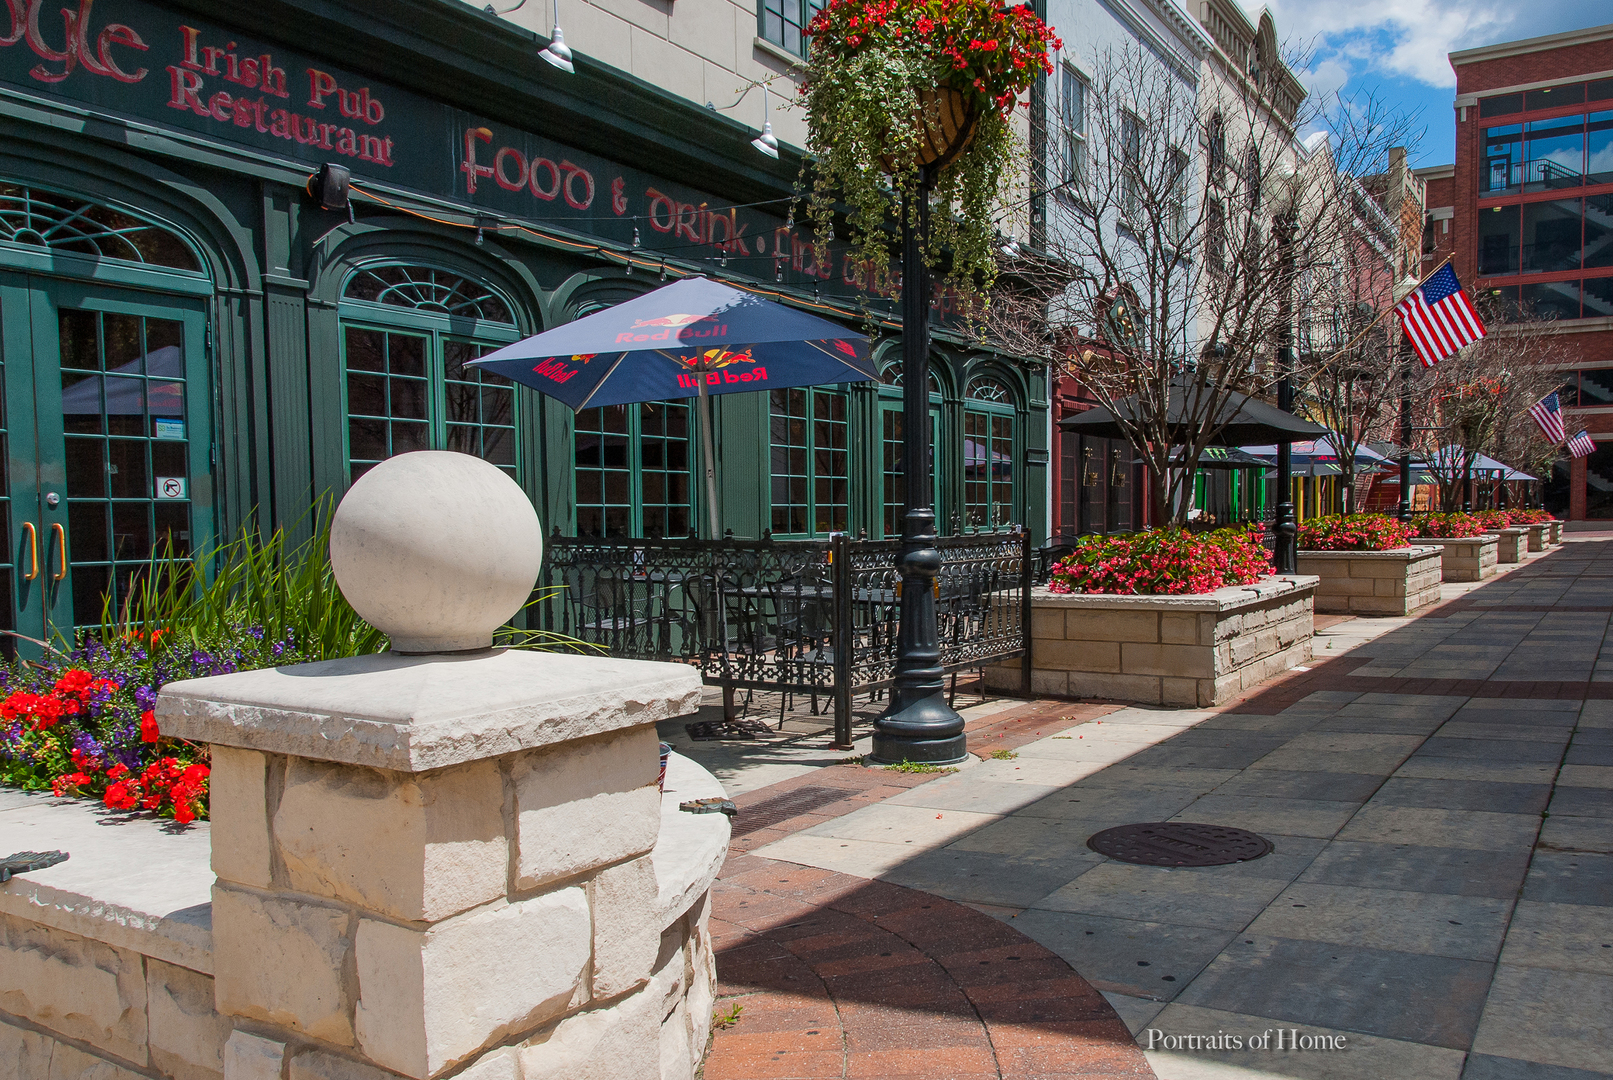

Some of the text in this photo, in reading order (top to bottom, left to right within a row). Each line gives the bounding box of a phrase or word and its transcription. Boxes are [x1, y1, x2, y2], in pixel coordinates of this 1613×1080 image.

[178, 25, 385, 125] Irish Pub
[165, 65, 396, 167] Restaurant
[611, 176, 628, 216] &
[615, 325, 728, 343] Red Bull
